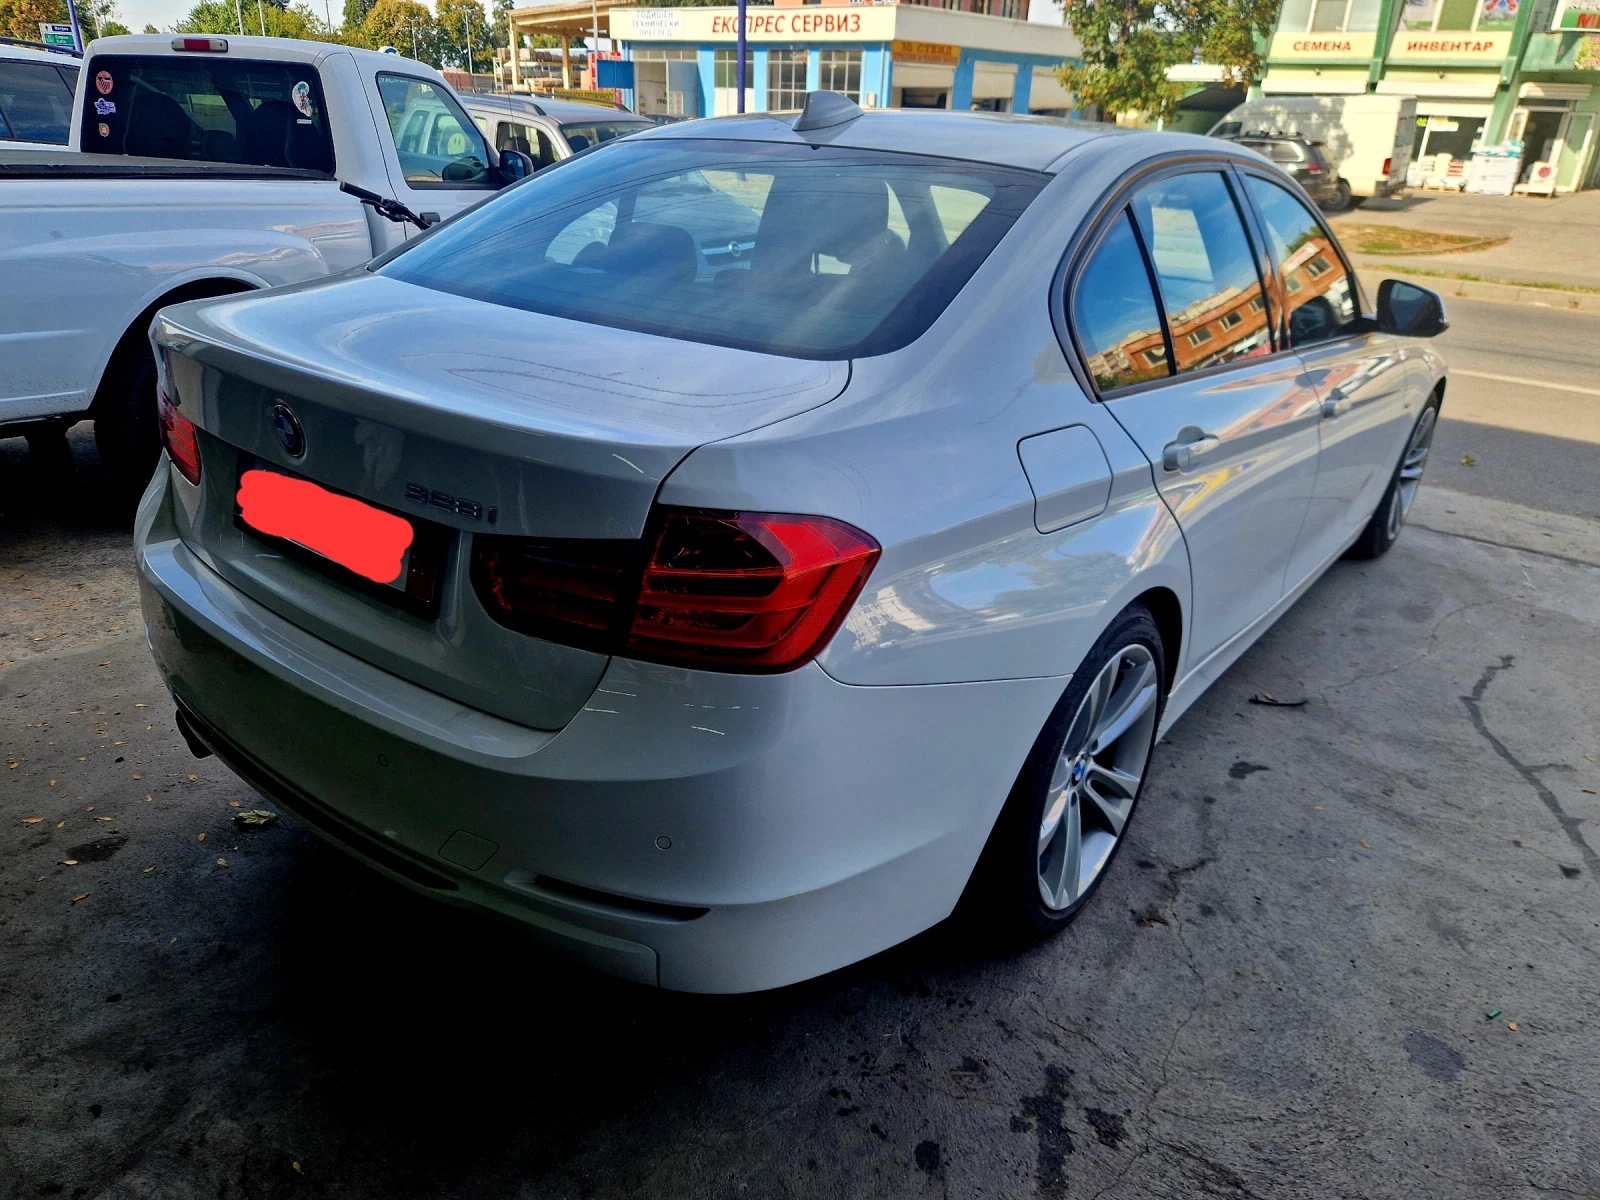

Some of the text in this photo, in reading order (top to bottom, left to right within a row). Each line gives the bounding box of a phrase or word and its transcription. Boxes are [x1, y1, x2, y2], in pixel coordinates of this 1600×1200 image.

[636, 11, 674, 19] ГОДИШЕН
[791, 14, 861, 33] СЕРВИЗ
[1293, 41, 1352, 51] СЕМЕНА
[1407, 41, 1494, 52] ИНВЕНТАР
